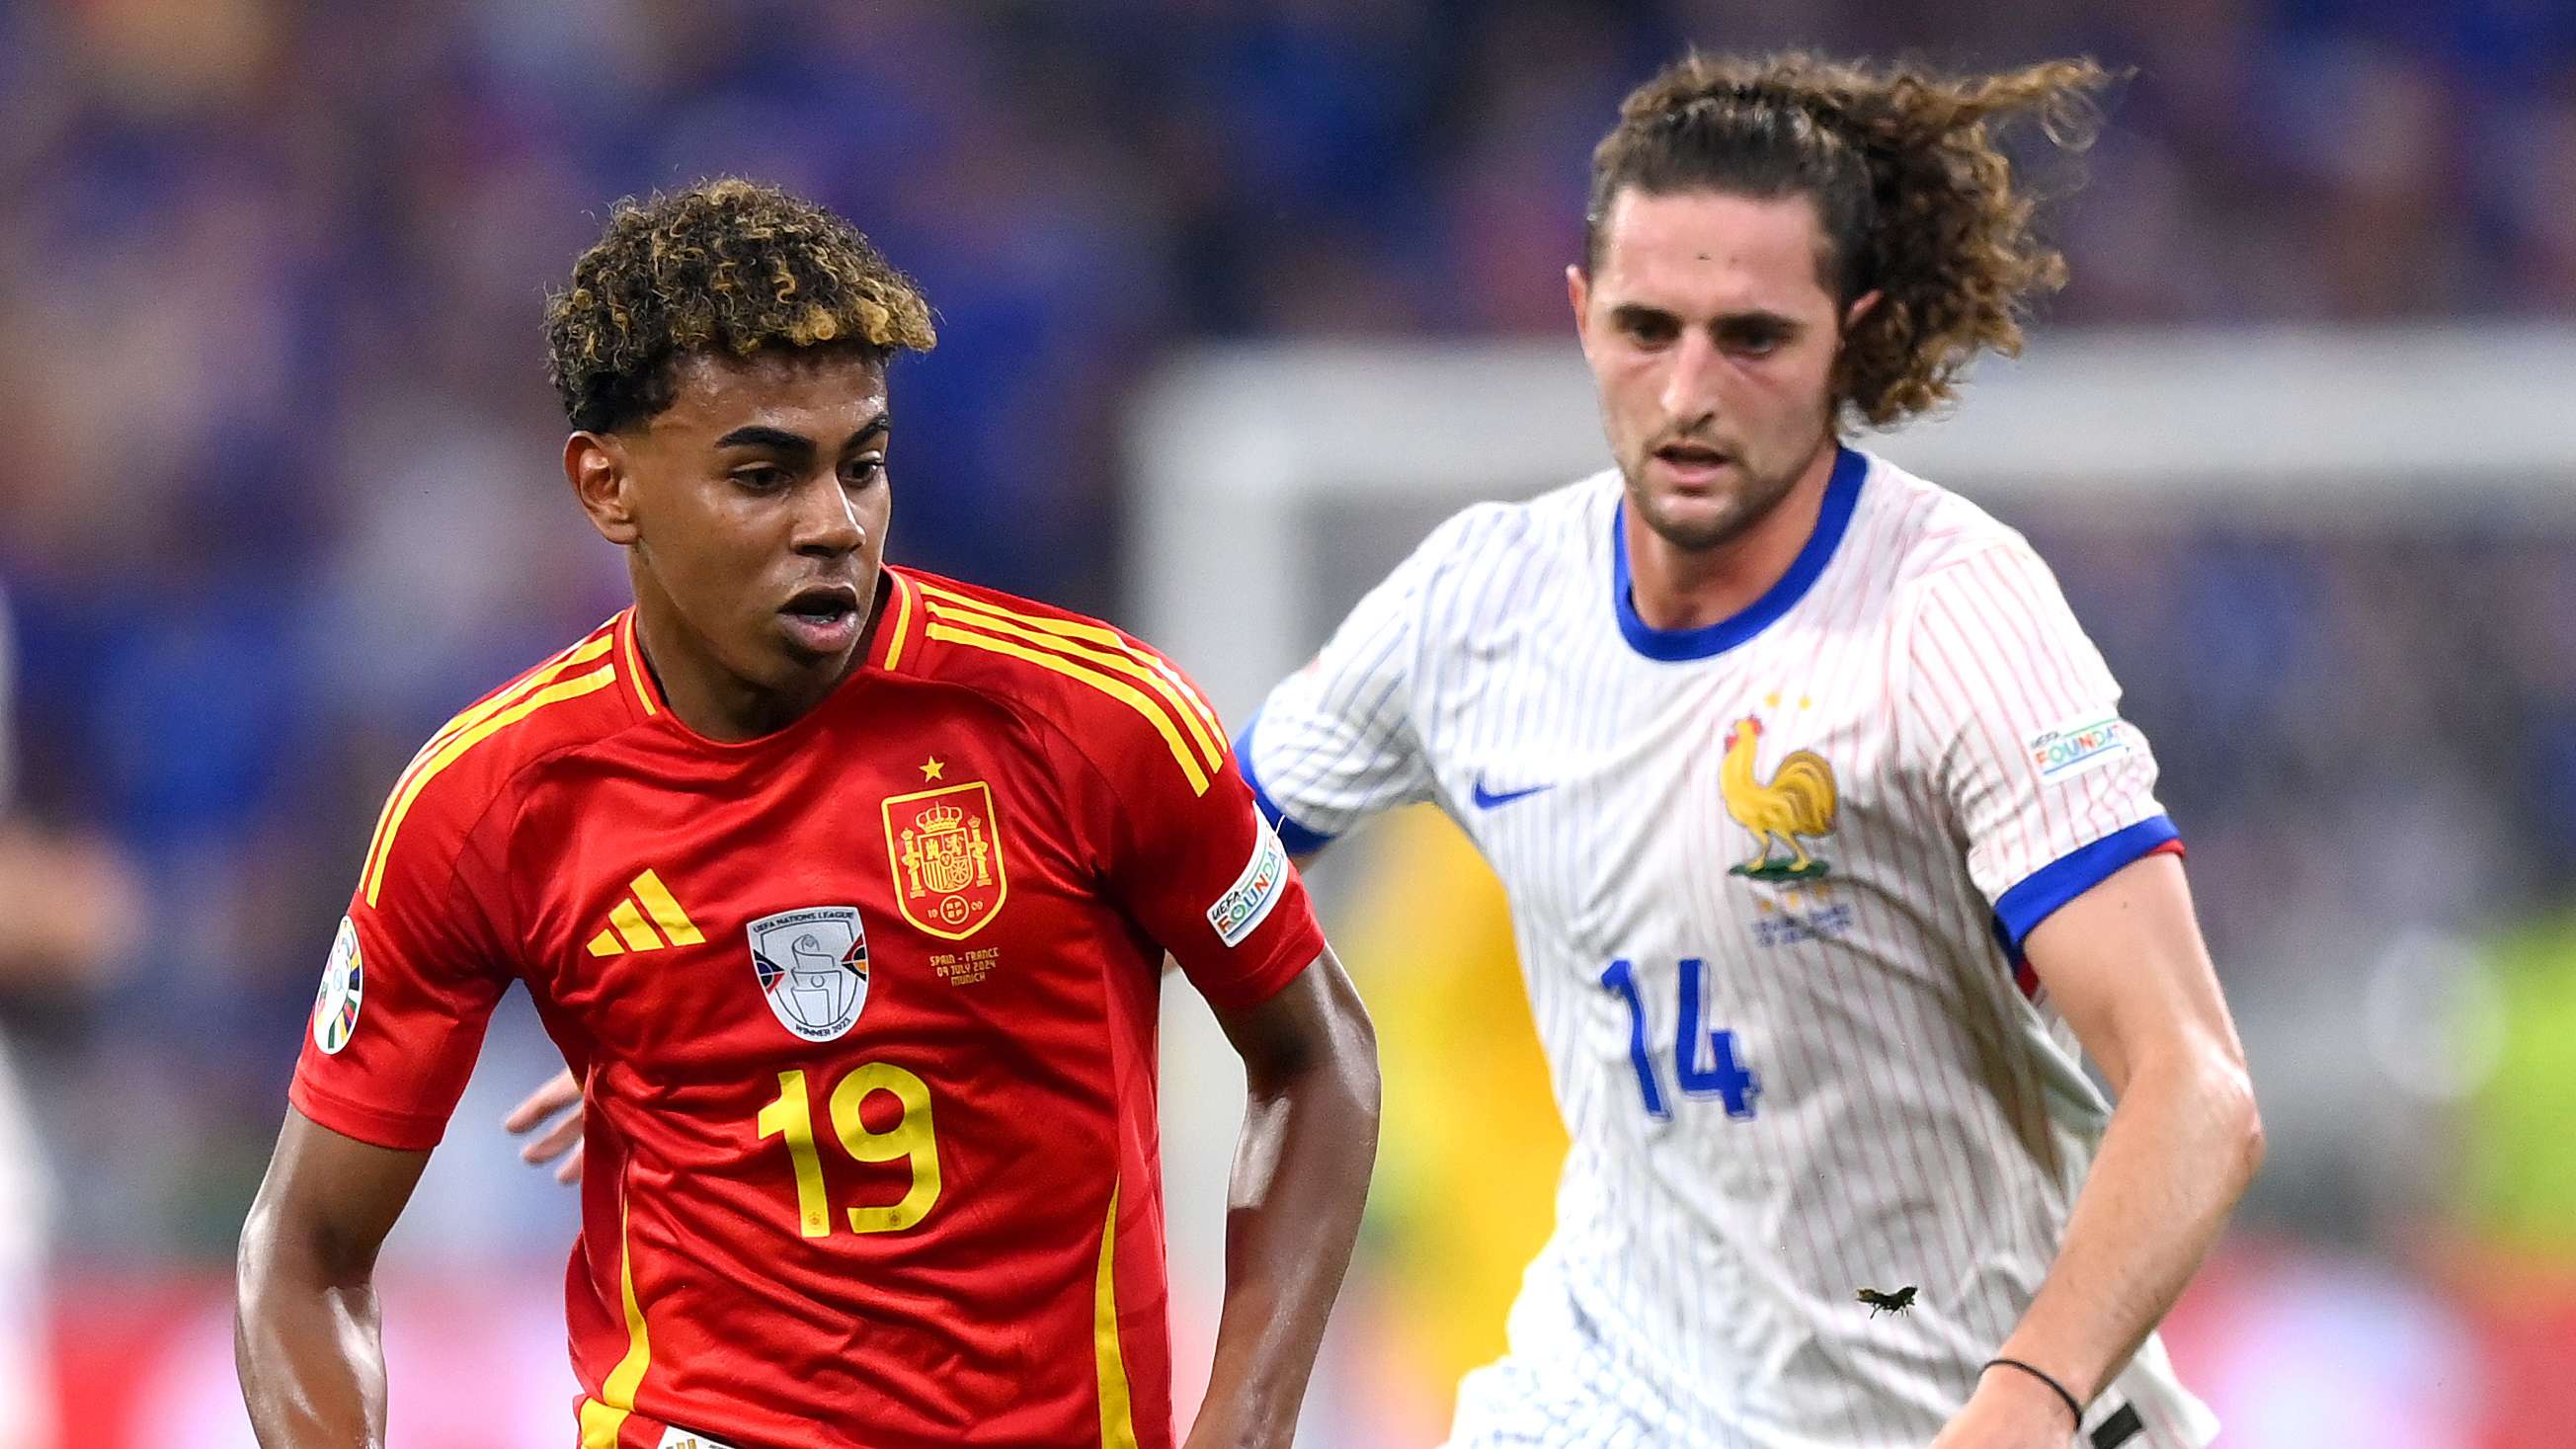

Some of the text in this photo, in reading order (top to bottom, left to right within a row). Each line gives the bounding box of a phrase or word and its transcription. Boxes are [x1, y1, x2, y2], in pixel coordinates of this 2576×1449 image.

[1211, 891, 1242, 921] UEFA
[753, 921, 775, 932] UEFA
[776, 912, 817, 926] NATIONS
[929, 954, 955, 966] SPAIN
[965, 947, 1000, 962] FRANCE
[936, 959, 996, 977] 09 JULY 2024
[951, 972, 986, 987] MUNICH
[796, 1023, 831, 1036] WINNER
[1601, 958, 1761, 1121] 14
[758, 1062, 941, 1238] 19
